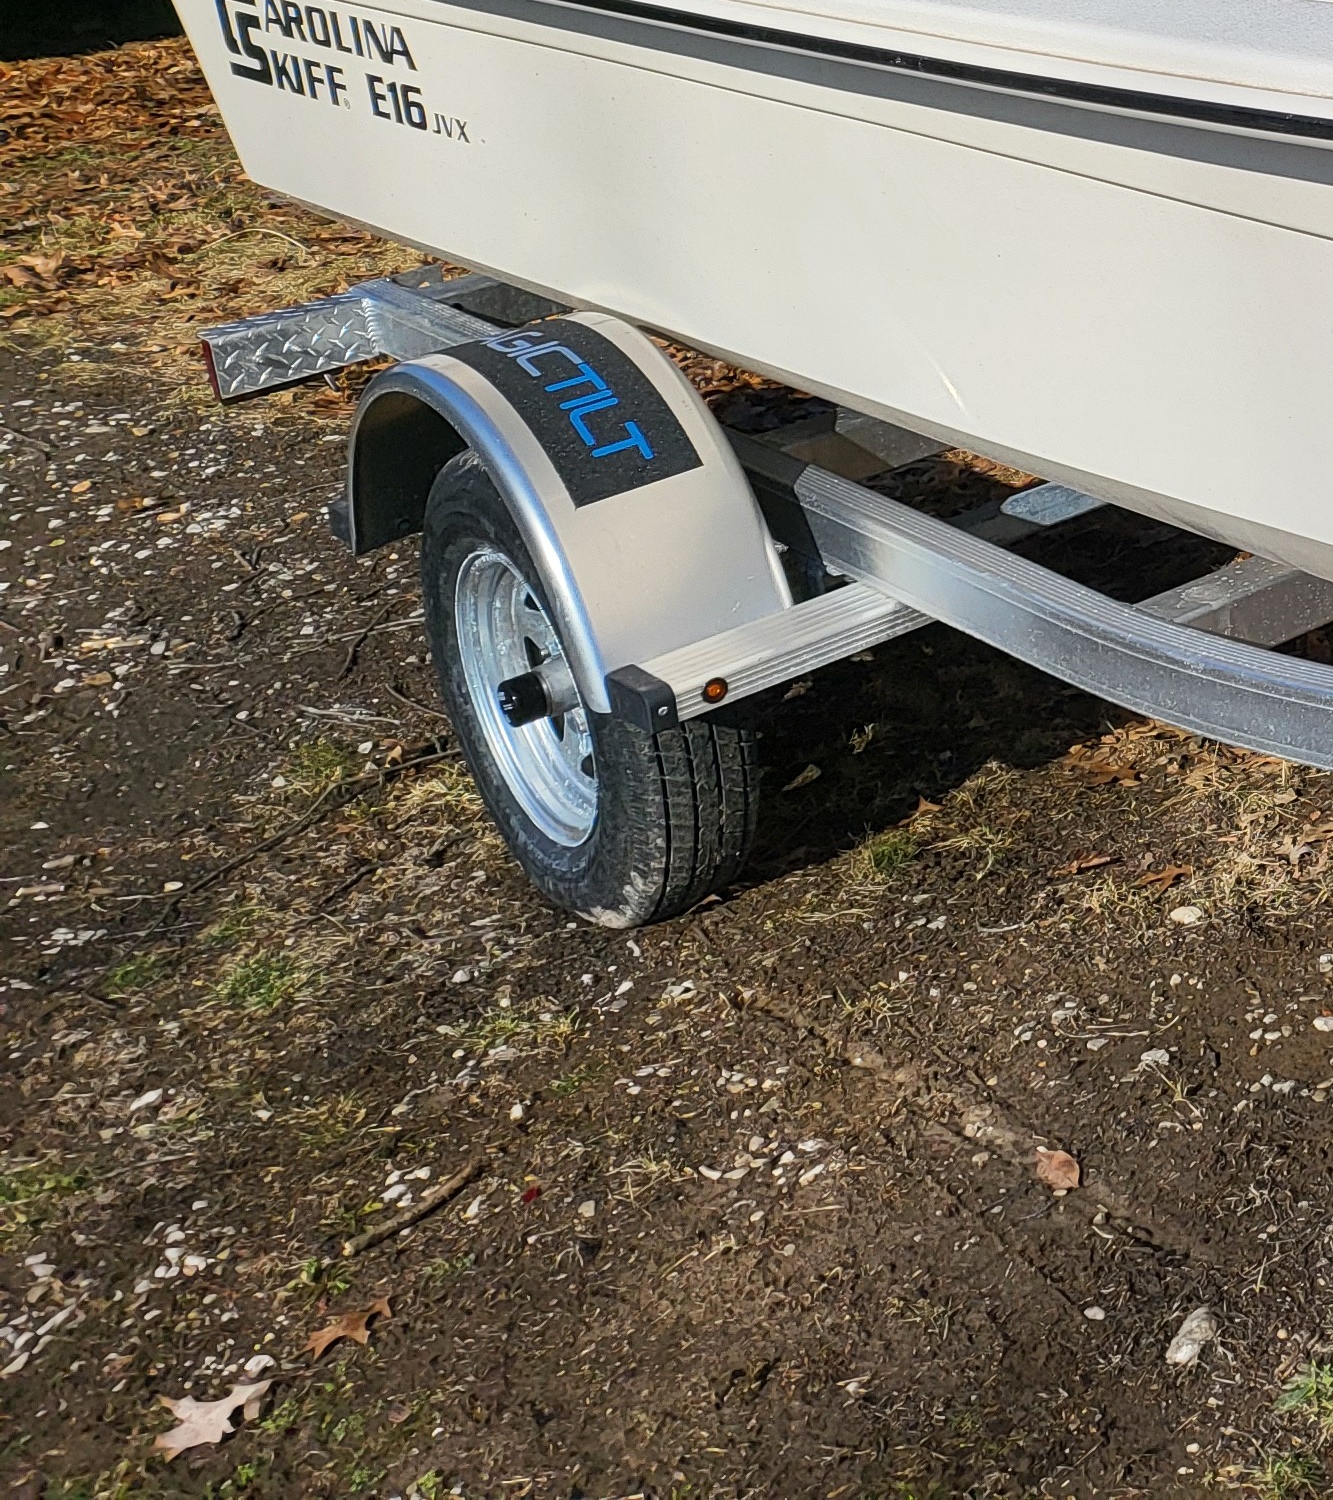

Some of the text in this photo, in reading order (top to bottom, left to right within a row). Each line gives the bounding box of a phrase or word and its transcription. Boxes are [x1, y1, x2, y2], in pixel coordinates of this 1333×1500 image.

[229, 11, 471, 144] SKIFF E16 JVX
[480, 330, 654, 460] GICTILT
